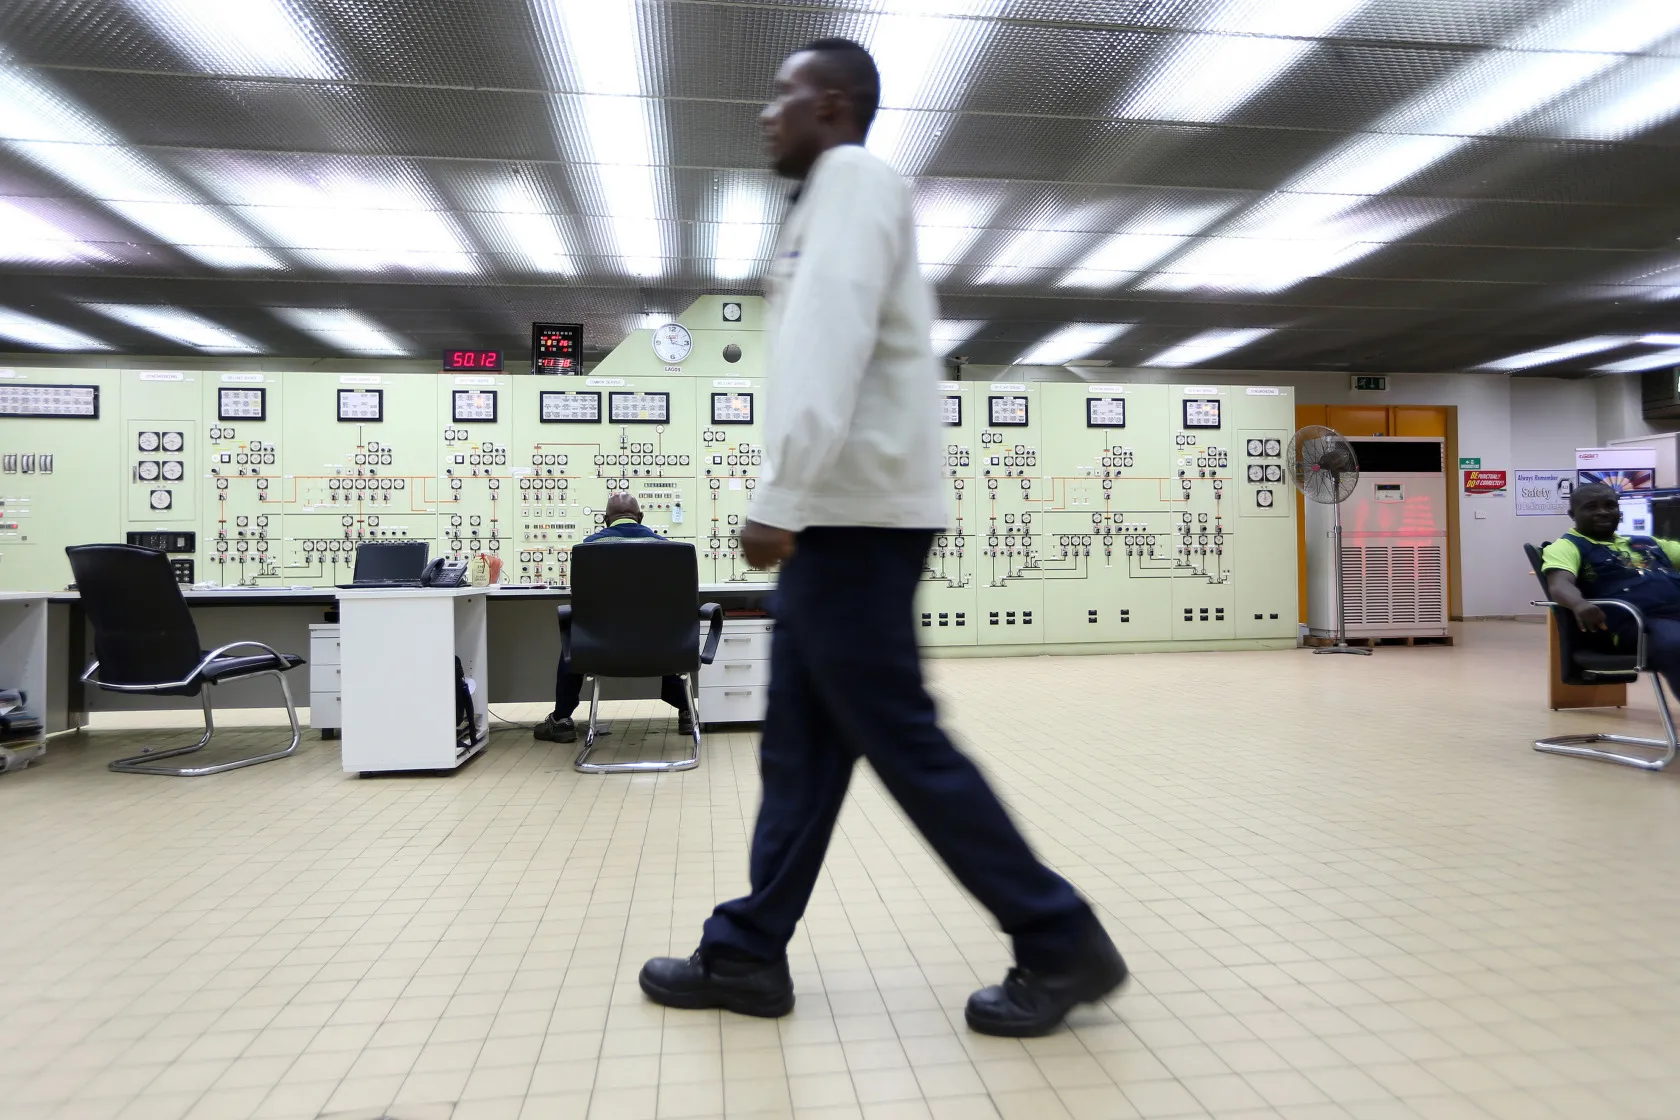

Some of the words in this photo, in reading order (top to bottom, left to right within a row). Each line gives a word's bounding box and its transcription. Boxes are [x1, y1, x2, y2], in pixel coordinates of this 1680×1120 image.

[1470, 472, 1479, 480] BE
[1517, 474, 1533, 482] Always
[1466, 480, 1476, 488] DO
[1521, 487, 1550, 500] Safety
